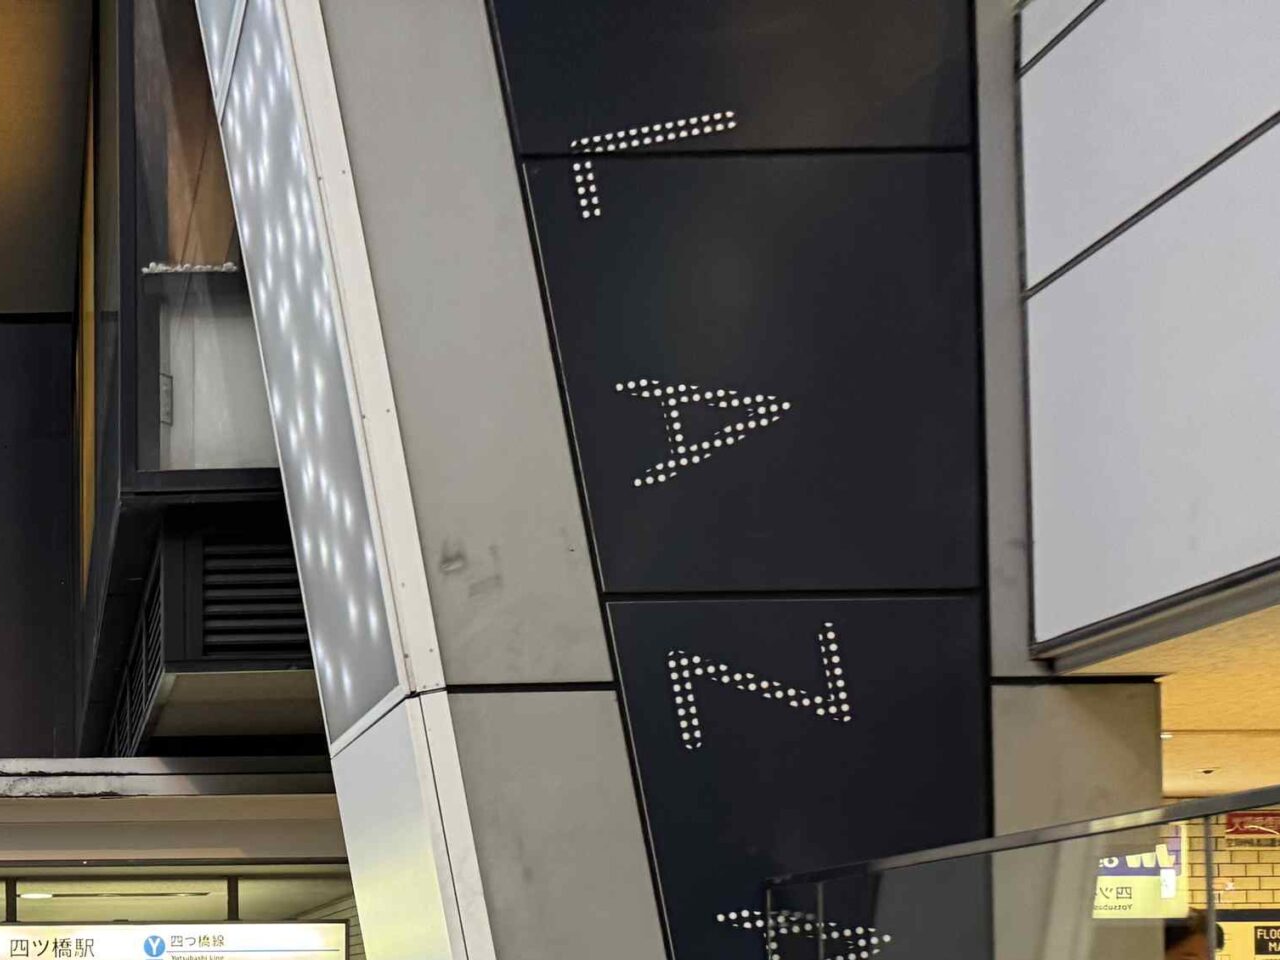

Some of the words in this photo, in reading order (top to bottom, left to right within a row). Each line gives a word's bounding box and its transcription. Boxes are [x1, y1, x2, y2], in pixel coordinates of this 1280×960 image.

[9, 937, 96, 958] 四ツ橋駅
[170, 935, 225, 948] 四つ橋線
